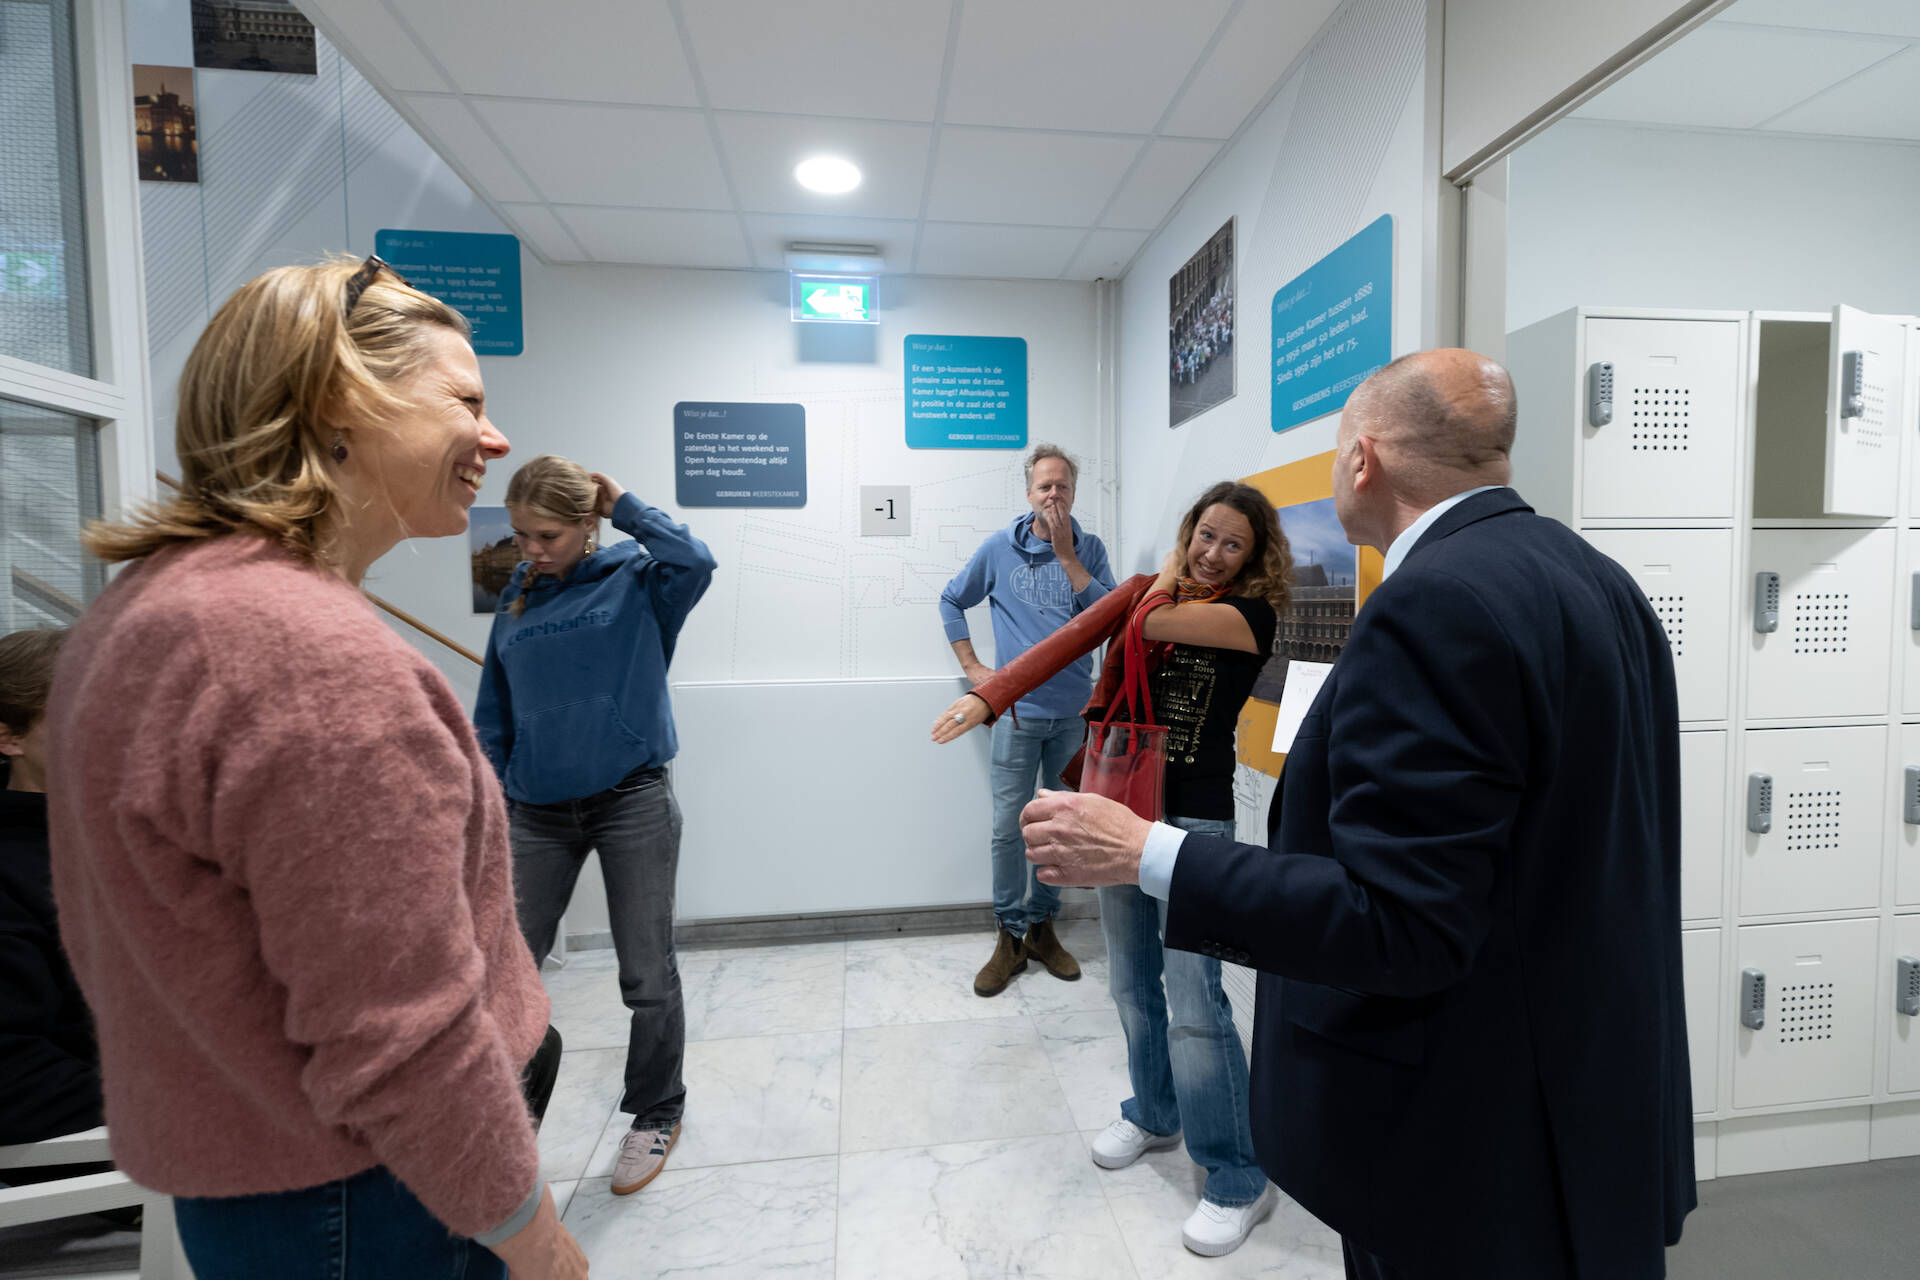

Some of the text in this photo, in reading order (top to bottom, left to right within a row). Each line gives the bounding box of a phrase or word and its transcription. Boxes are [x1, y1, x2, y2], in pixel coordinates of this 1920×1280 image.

[429, 263, 444, 273] het
[445, 265, 466, 274] soms
[468, 265, 485, 274] ook
[486, 265, 501, 275] wel
[468, 278, 497, 288] duurde
[450, 290, 486, 301] wijziging
[487, 292, 502, 300] van
[475, 304, 494, 313] zelfs
[495, 304, 508, 313] tot
[1277, 337, 1285, 349] De
[1286, 326, 1305, 343] Eerste
[1306, 311, 1327, 331] Kamer
[1328, 296, 1352, 318] tussen
[1277, 306, 1369, 367] en 1956 maar 50 leden had.
[912, 364, 920, 372] Er
[993, 366, 1002, 374] de
[1277, 368, 1293, 385] Sinds
[1294, 359, 1310, 378] 1956
[1310, 353, 1322, 369] zijn
[1323, 346, 1336, 361] het
[1336, 343, 1345, 355] er
[911, 376, 940, 385] plenaire
[942, 377, 957, 385] zaal
[972, 377, 982, 385] de
[983, 378, 1005, 386] Eerste
[912, 388, 934, 396] Kamer
[959, 388, 995, 398] Afhankelijk
[912, 399, 1007, 409] je positie in de zaal ziet dit
[1292, 386, 1331, 412] GESCHIEDENIS
[912, 410, 948, 419] kunstwerk
[958, 411, 982, 420] anders
[684, 432, 768, 442] De Eerste Kamer op de
[684, 444, 716, 453] zaterdag
[718, 444, 726, 452] in
[727, 444, 740, 452] het
[741, 444, 774, 453] weekend
[684, 456, 788, 466] Open Monumentendag altijd
[684, 468, 746, 477] open dag houdt.
[715, 490, 800, 498] GEBRUIKEN #EERSTEKAMER
[874, 499, 897, 520] -1
[1193, 665, 1215, 674] SOHO
